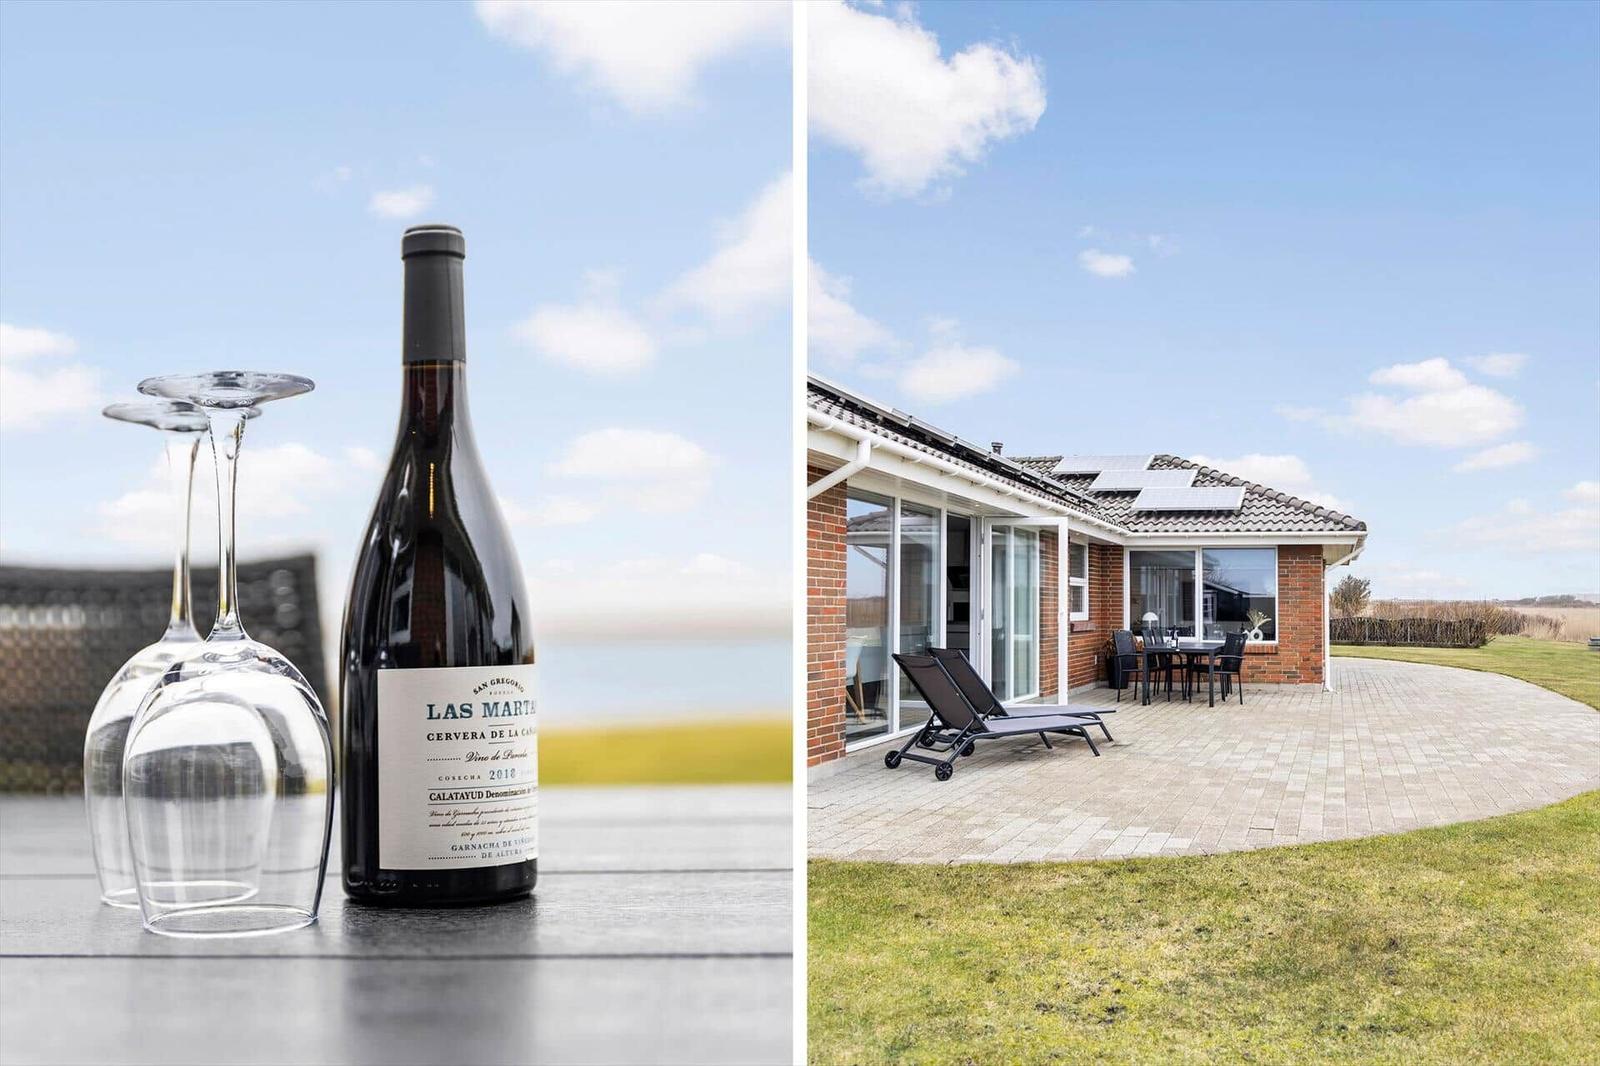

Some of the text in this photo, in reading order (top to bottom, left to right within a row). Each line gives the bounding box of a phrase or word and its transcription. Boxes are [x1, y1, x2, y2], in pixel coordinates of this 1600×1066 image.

[473, 677, 525, 695] SAN GREGORIO
[426, 703, 473, 720] LAS
[427, 731, 486, 741] CERVERA
[491, 730, 505, 739] DE
[509, 729, 518, 737] LA
[464, 751, 489, 762] Vino
[490, 750, 500, 760] de
[489, 768, 516, 780] 2018
[429, 791, 484, 802] CALATAYUD
[451, 842, 500, 852] GARNACHA
[502, 840, 512, 848] DE
